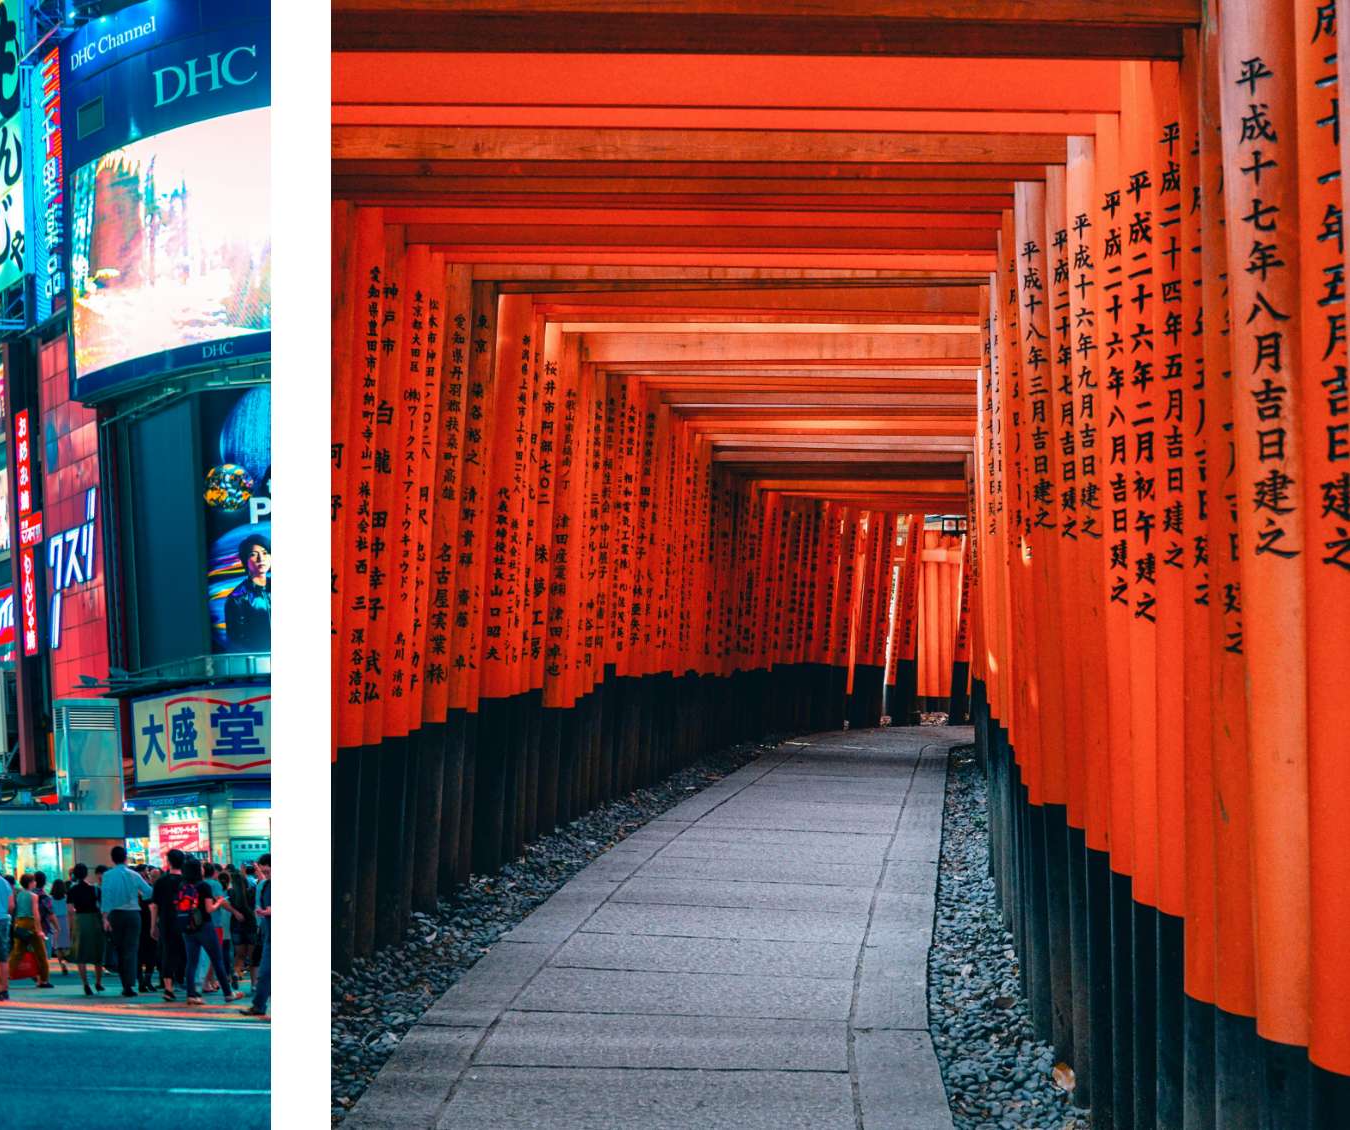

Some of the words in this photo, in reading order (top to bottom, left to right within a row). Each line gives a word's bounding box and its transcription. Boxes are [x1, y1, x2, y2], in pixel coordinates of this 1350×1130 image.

[70, 44, 97, 72] DHC
[98, 16, 157, 55] Channel
[152, 45, 259, 108] DHC
[201, 340, 234, 358] DHC
[380, 282, 399, 354] 神戸市
[1021, 240, 1056, 530] 平成十八年三月吉日建之
[1072, 212, 1103, 540] 平成十六年九月吉日建之
[1101, 188, 1129, 606] 平成二十六年八月吉日建之
[1126, 169, 1156, 623] 平成二十六年二月初午建之
[1158, 121, 1185, 570] 平成二十四年五月吉日建之
[1234, 56, 1301, 560] 平成十七年八月吉日建之
[142, 703, 266, 767] 大盛堂
